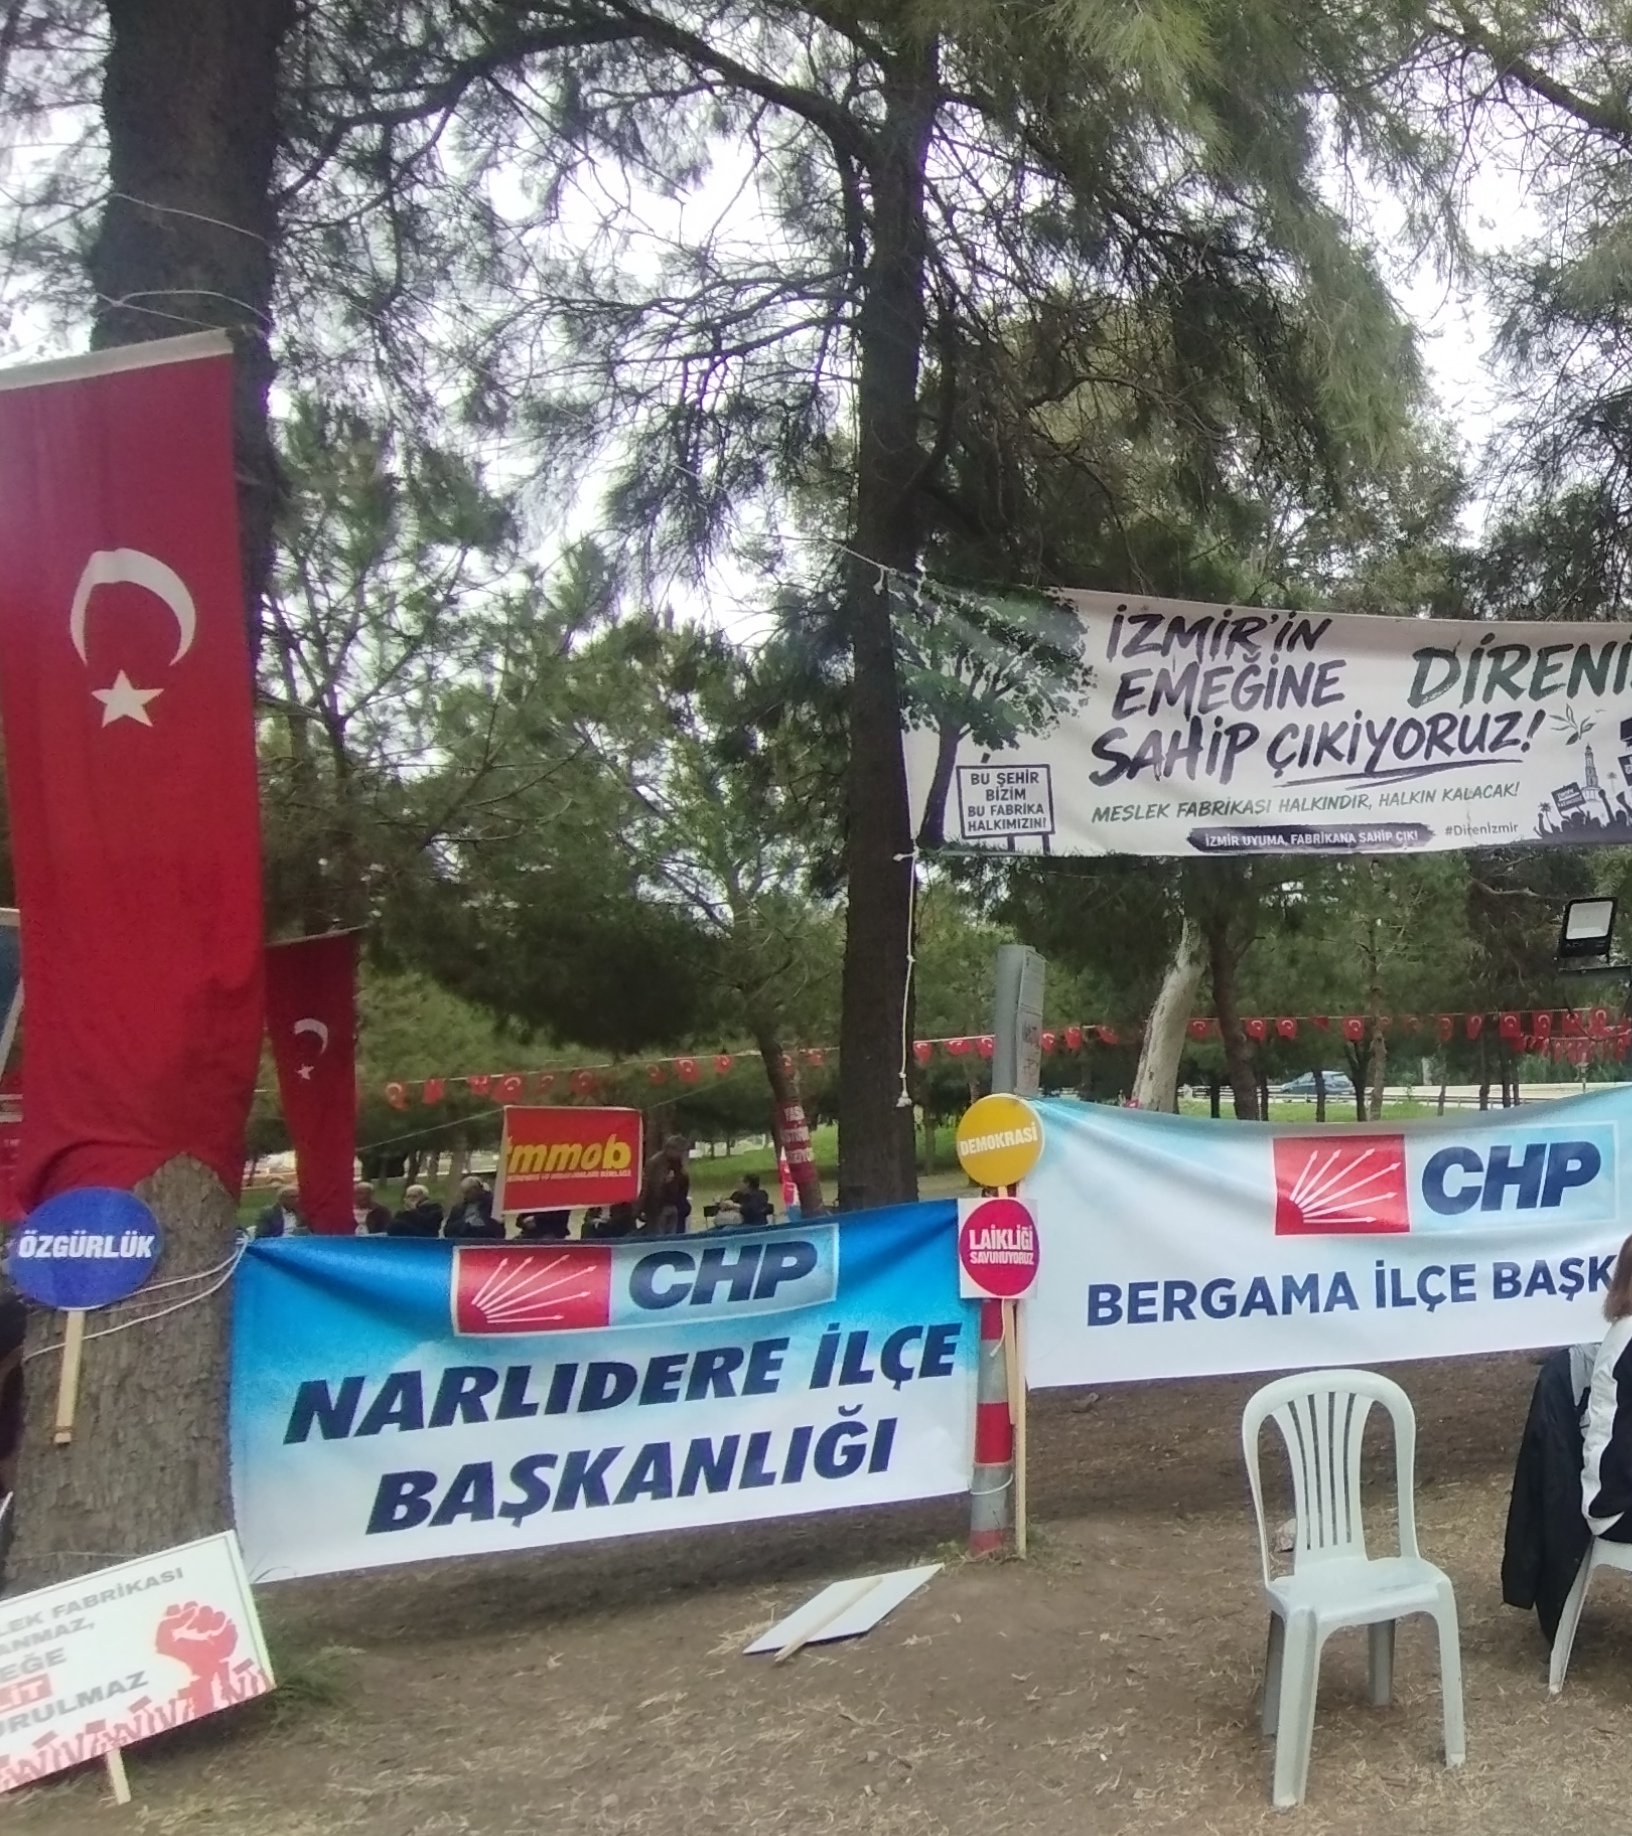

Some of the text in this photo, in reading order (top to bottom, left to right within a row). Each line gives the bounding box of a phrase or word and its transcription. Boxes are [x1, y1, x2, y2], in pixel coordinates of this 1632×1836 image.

[1106, 604, 1333, 661] İZMİR'İN
[1112, 652, 1347, 720] EMEĞİNE
[1089, 713, 1260, 786] SAHİP
[971, 769, 1039, 787] BU ŞEHİR
[986, 786, 1026, 801] BİZİM
[968, 803, 1044, 817] BU FABRİKA
[1092, 803, 1171, 823] MESLEK
[1176, 796, 1272, 818] FABRİKASI
[1378, 788, 1436, 807] HALKIN
[1441, 781, 1520, 802] KALACAK!
[1205, 833, 1240, 847] İZMİR
[1290, 830, 1356, 845] FABRİKANA
[1359, 830, 1393, 843] SAHİP
[960, 1121, 1037, 1156] DEMOKRASİ
[1421, 1140, 1601, 1216] CHP
[18, 1226, 155, 1260] ÖZGÜRLÜK
[969, 1224, 1034, 1251] LAİKLİĞİ
[969, 1250, 1035, 1265] SAVUNUYORUZ
[627, 1241, 819, 1310] CHP
[1087, 1269, 1360, 1327] BERGAMA
[1375, 1259, 1476, 1314] İLÇE
[284, 1322, 962, 1445] NARLIDERE İLÇE
[365, 1404, 898, 1528] BAŞKANLIĞI
[52, 1567, 184, 1620] FABRİKASI
